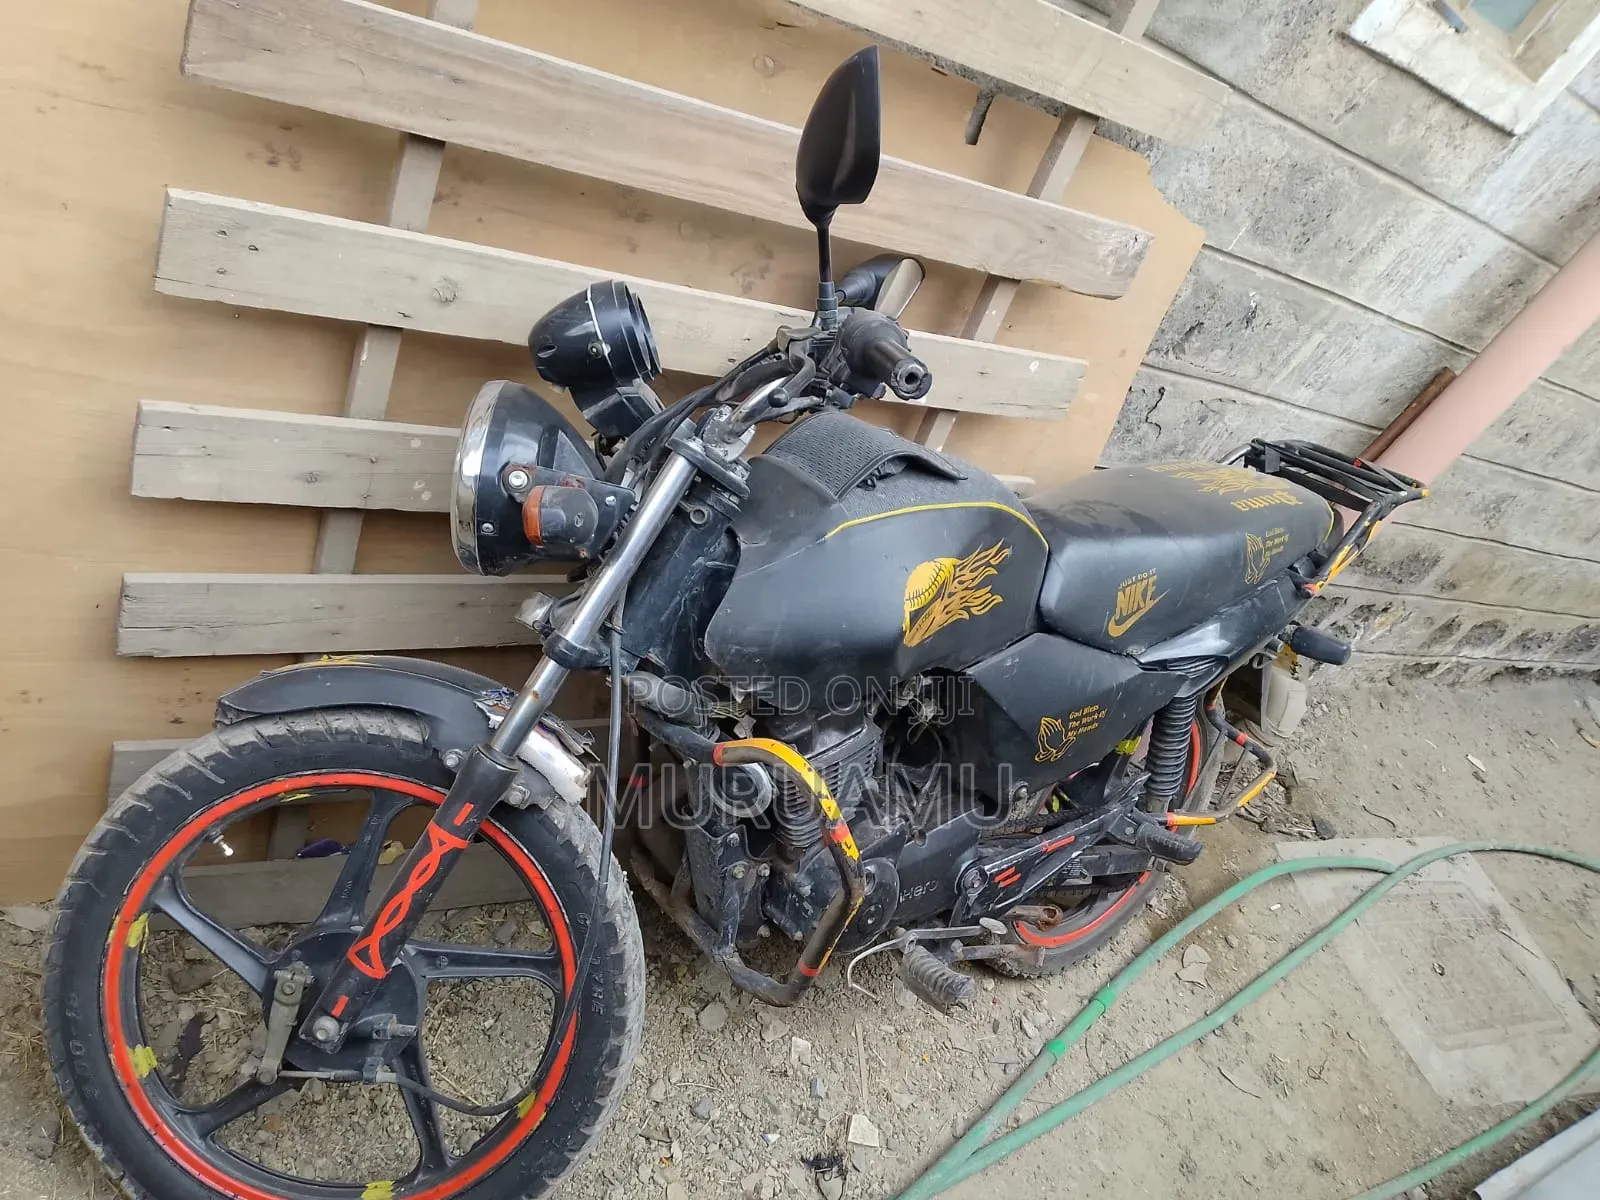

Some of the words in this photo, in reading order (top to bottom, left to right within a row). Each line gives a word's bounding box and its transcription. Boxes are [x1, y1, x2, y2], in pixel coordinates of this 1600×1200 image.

[1118, 575, 1136, 590] JUST
[1137, 571, 1148, 580] DO
[1149, 567, 1157, 575] IT
[1115, 575, 1158, 620] NIKE
